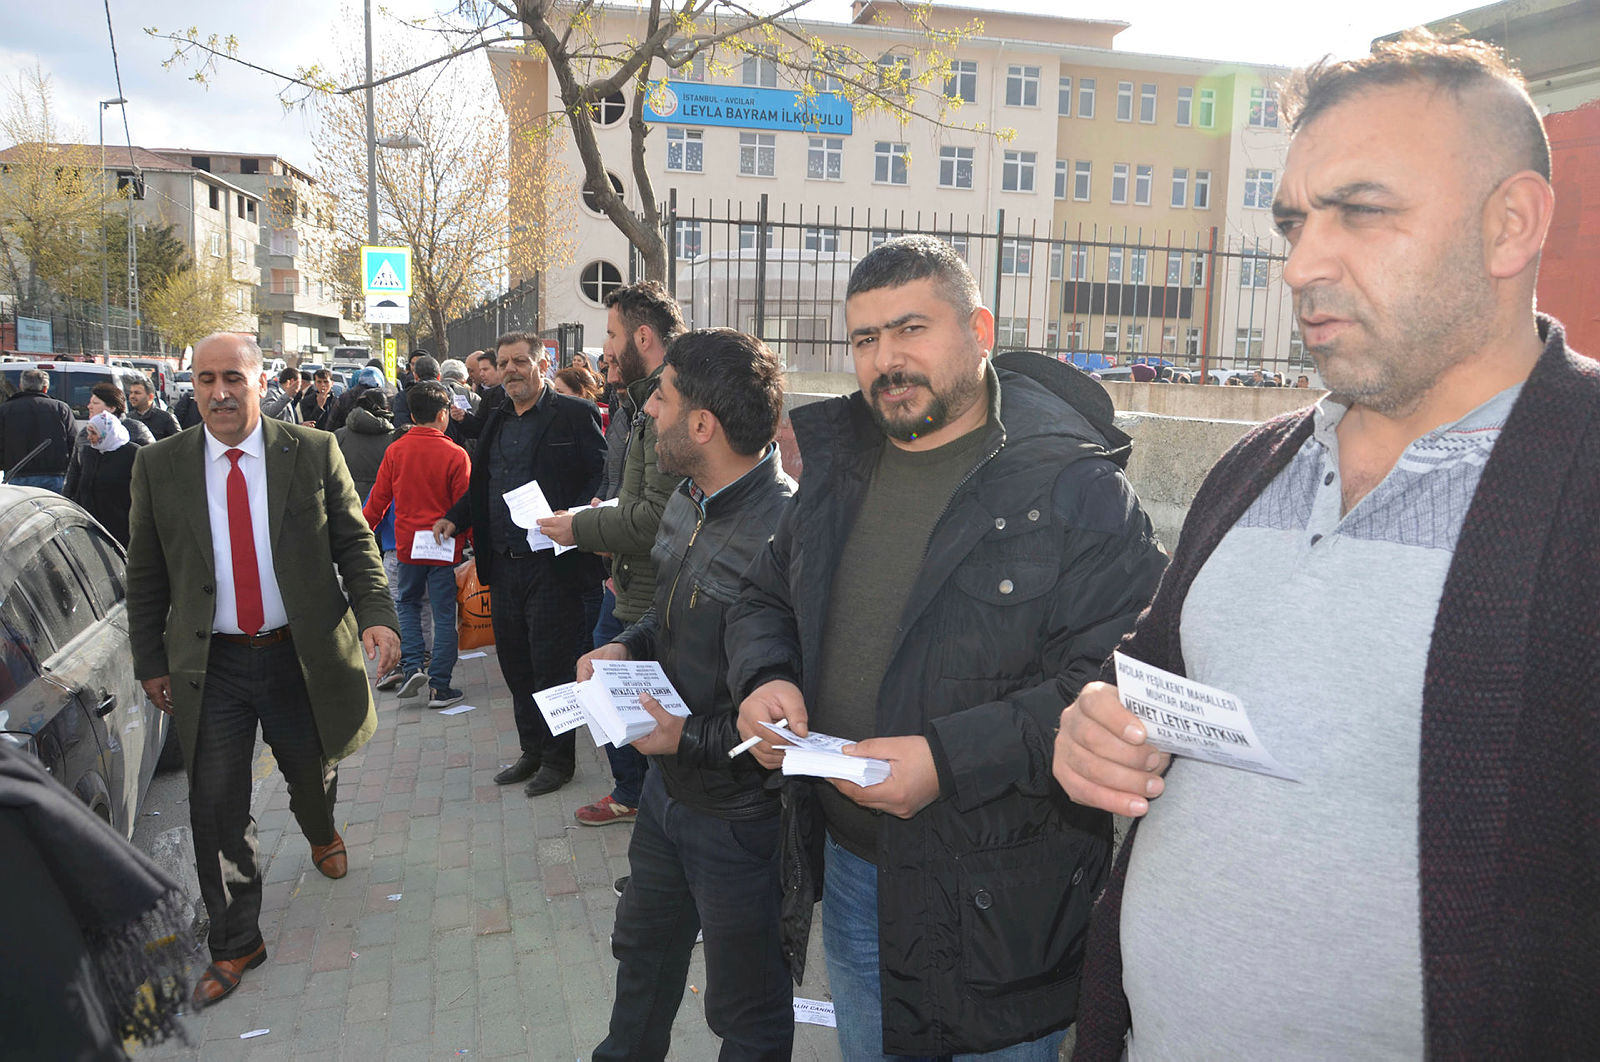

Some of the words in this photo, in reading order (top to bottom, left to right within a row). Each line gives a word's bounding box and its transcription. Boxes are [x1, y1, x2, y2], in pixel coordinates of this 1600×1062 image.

[682, 94, 719, 103] İSTANBUL
[682, 104, 722, 118] LEYLA
[726, 107, 778, 122] BAYRAM
[782, 108, 843, 126] İLKOKULU
[1118, 662, 1145, 681] AVCILAR
[1146, 687, 1178, 708] MUHTAR
[550, 704, 580, 718] TUTKUN
[1125, 698, 1158, 722] MEMET
[1194, 722, 1252, 748] TUTKUN
